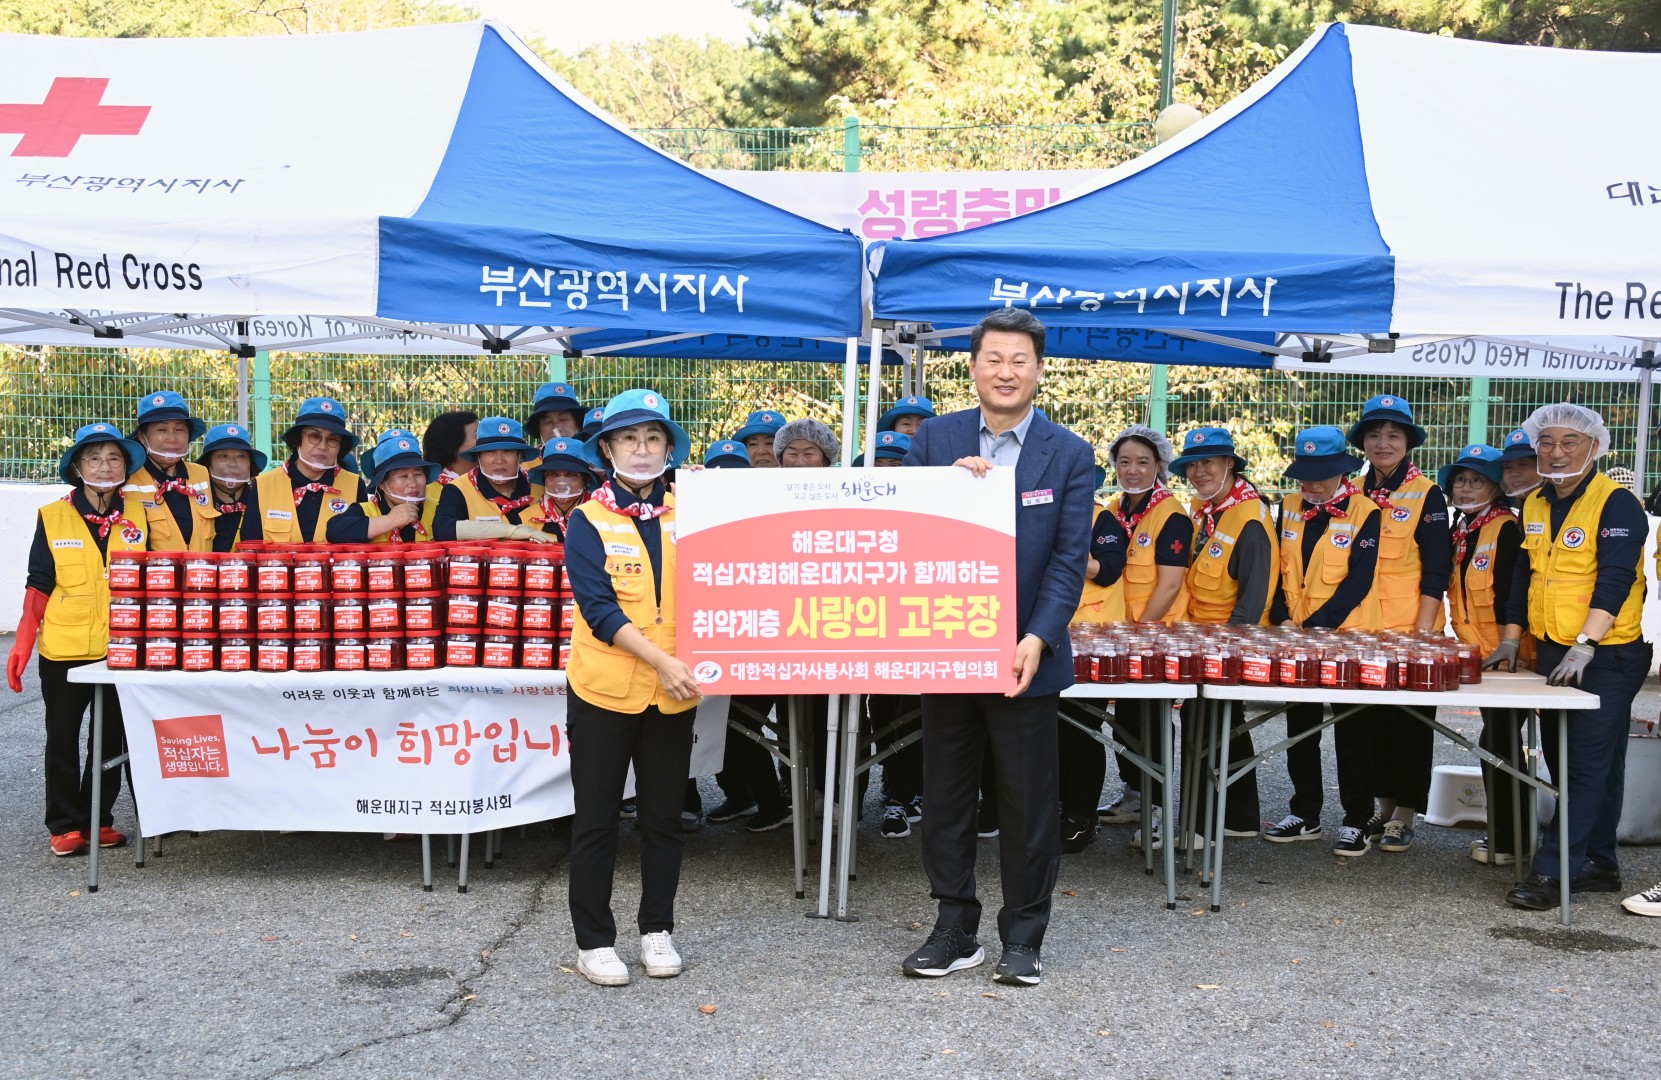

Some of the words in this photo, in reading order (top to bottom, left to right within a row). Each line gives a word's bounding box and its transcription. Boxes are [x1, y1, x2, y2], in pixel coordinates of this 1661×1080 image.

[16, 173, 245, 194] 부산광역시지사
[55, 252, 111, 289] Red
[122, 253, 203, 290] Cross
[480, 266, 749, 312] 부산광역시지사
[1555, 282, 1613, 319] The
[817, 482, 831, 490] 도시
[841, 480, 897, 502] 해운대
[792, 529, 898, 554] 해운대구청
[692, 561, 907, 586] 적십자회해운대지구가
[914, 560, 1000, 585] 함께하는
[692, 609, 780, 638] 취약계층
[787, 595, 886, 639] 사랑의
[898, 594, 1000, 639] 고추장
[730, 661, 869, 681] 대한적십자사봉사회
[874, 660, 998, 680] 해운대지구협의회
[282, 689, 326, 701] 어려운
[333, 688, 376, 700] 이웃과
[382, 686, 440, 700] 함께하는
[448, 685, 504, 695] 희망나눔
[160, 736, 192, 746] Saving
[193, 734, 220, 744] Lives,
[251, 723, 378, 769] 나눔이
[396, 717, 570, 767] 희망입니
[162, 746, 221, 761] 적십자는
[165, 761, 224, 773] 생명입니다.
[356, 798, 423, 815] 해운대지구
[429, 794, 512, 816] 적십자봉사회
